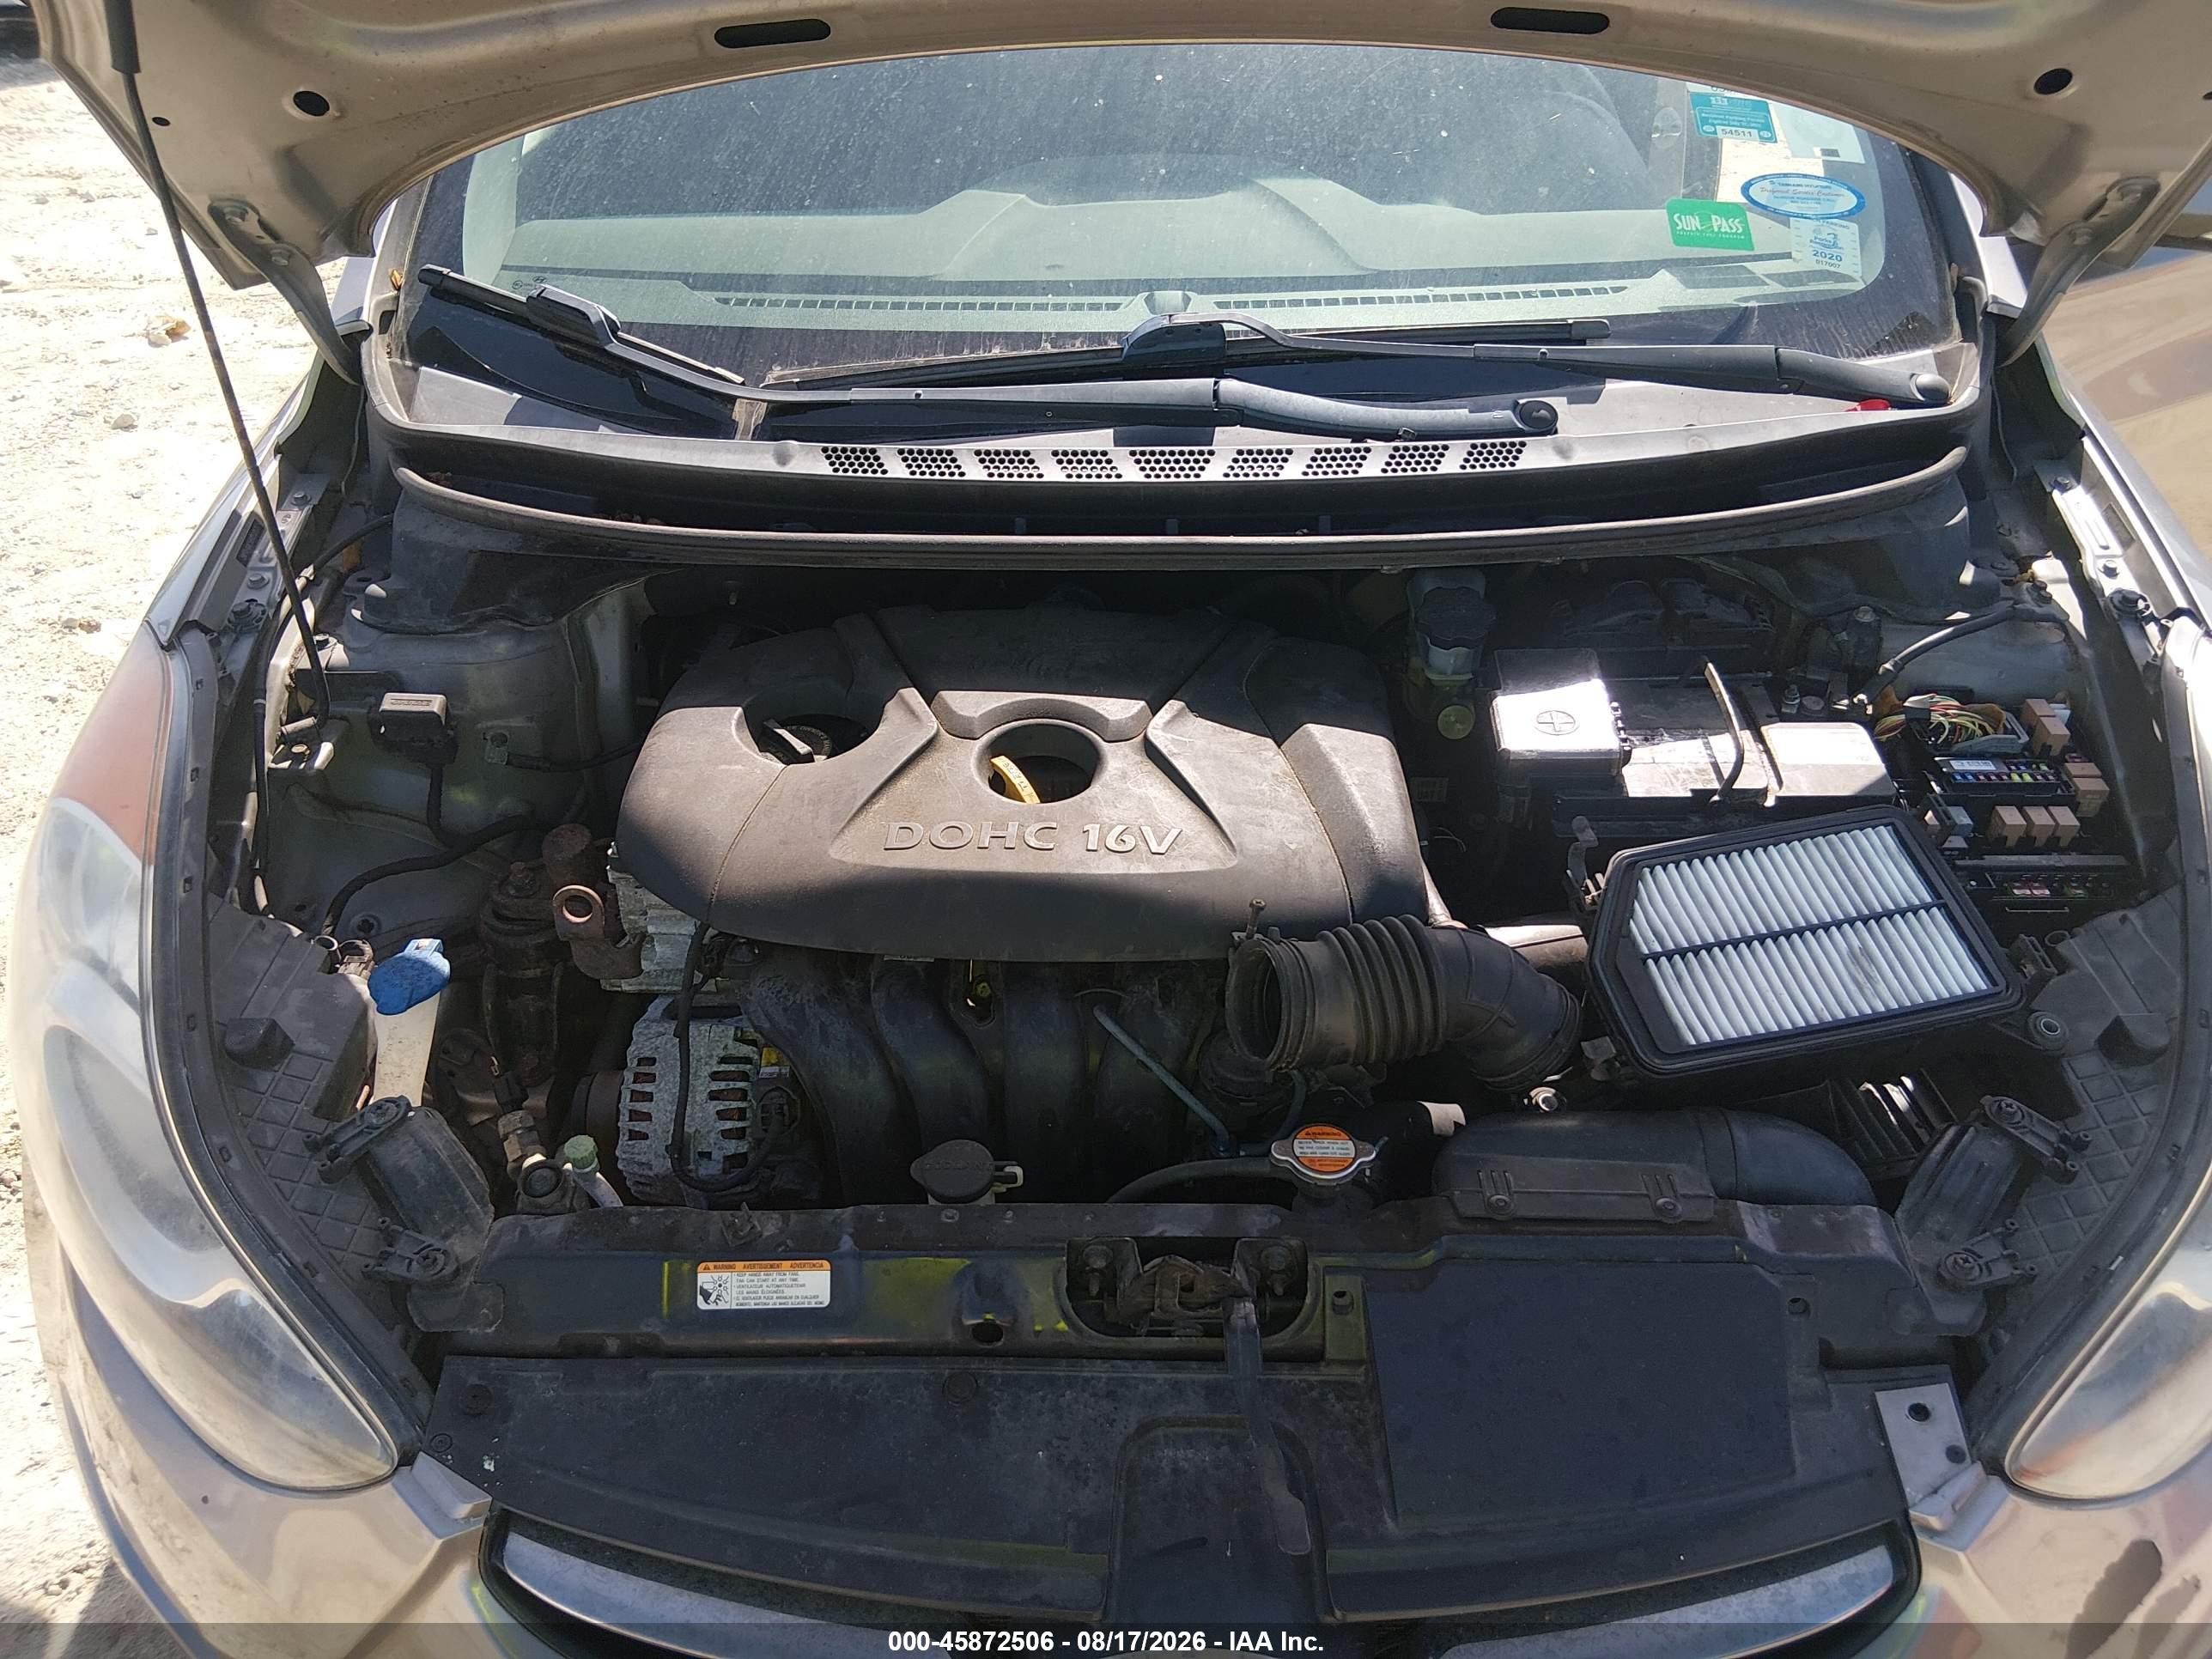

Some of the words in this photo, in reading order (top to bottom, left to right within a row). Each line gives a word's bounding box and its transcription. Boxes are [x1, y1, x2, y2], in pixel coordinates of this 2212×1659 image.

[1721, 129, 1752, 137] 54511
[1673, 213, 1701, 230] SUN
[1711, 215, 1743, 234] PASS
[1813, 250, 1842, 262] 2020
[884, 821, 1058, 851] DOHC
[1082, 823, 1183, 855] 16V
